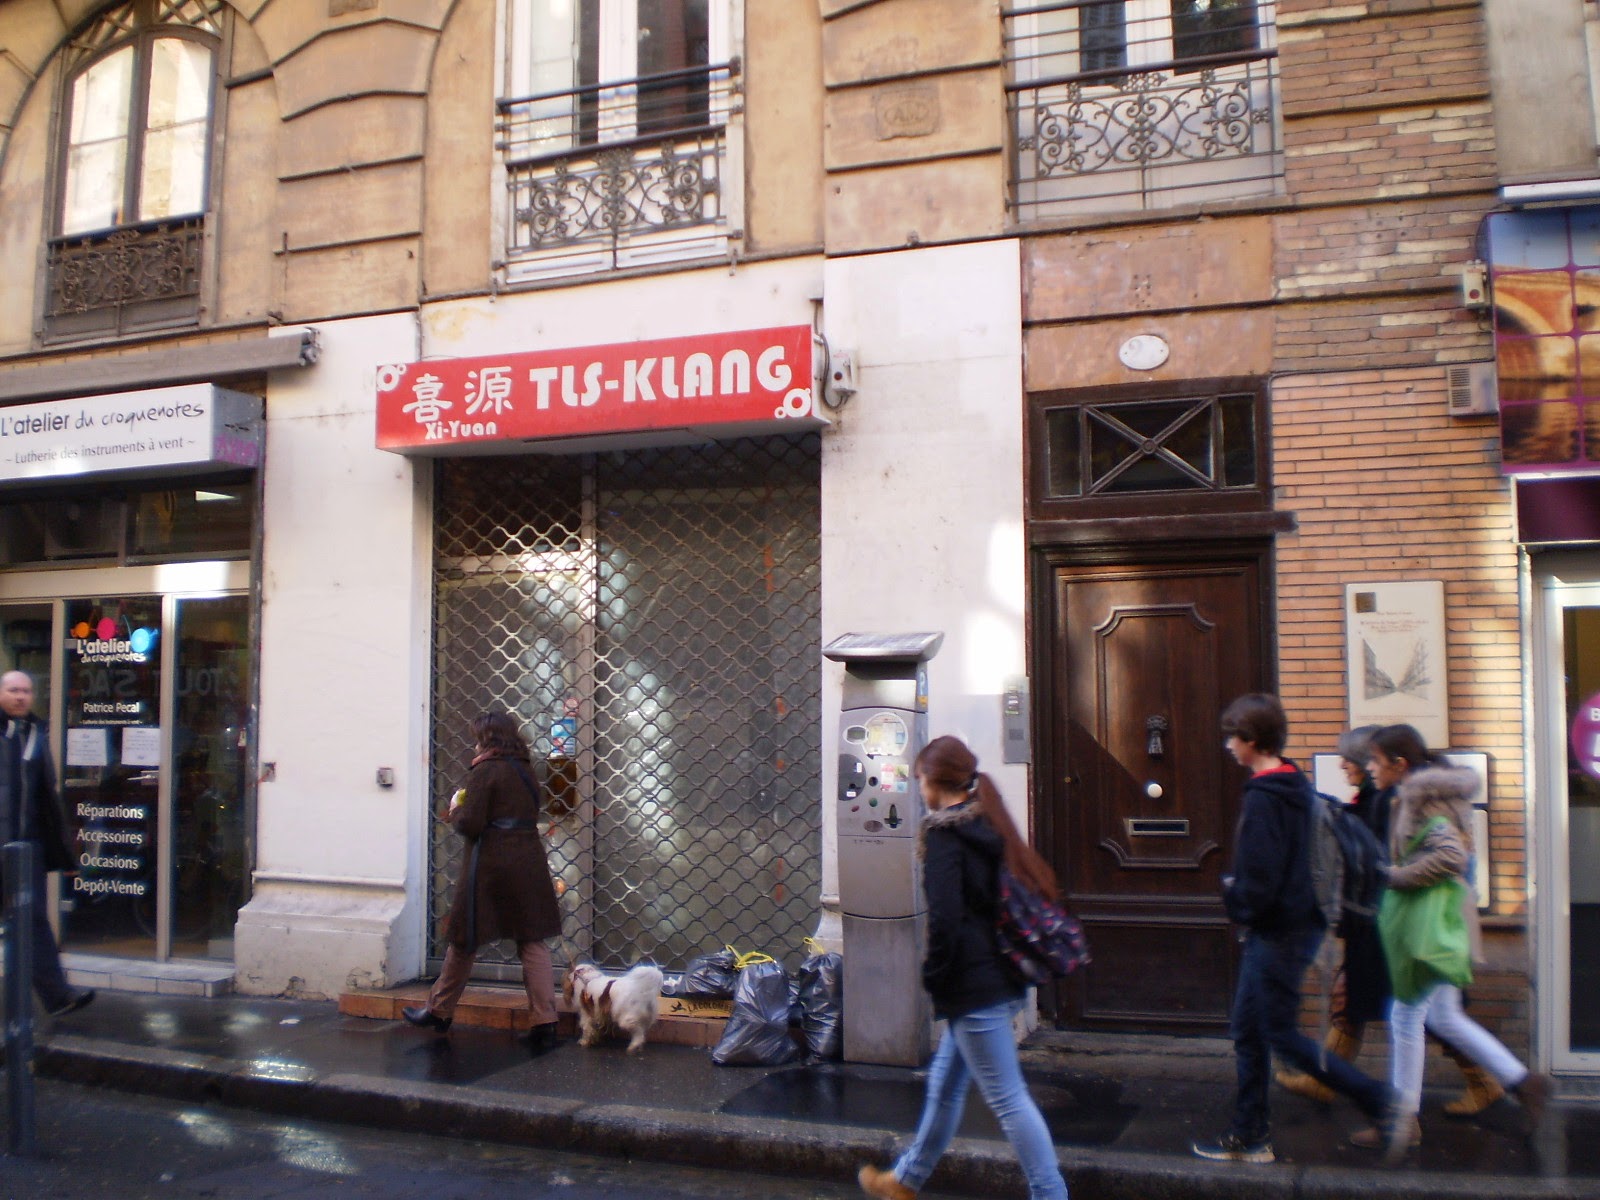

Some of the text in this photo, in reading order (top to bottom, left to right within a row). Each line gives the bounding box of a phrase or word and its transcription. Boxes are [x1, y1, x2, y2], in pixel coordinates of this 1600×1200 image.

[529, 345, 792, 410] TLS-KLANG
[402, 366, 513, 424] 喜源
[1, 401, 205, 437] L'atelier du croquenotes
[425, 420, 497, 440] Xi-Yuan
[81, 440, 145, 458] instruments
[148, 438, 155, 451] à
[158, 438, 183, 450] vent
[77, 638, 130, 654] L'atelier
[83, 702, 140, 713] Patrice Pecal
[77, 803, 144, 821] Réparations
[77, 828, 143, 844] Accessoires
[80, 852, 139, 870] Occasions
[74, 877, 145, 895] Depôt-Vente
